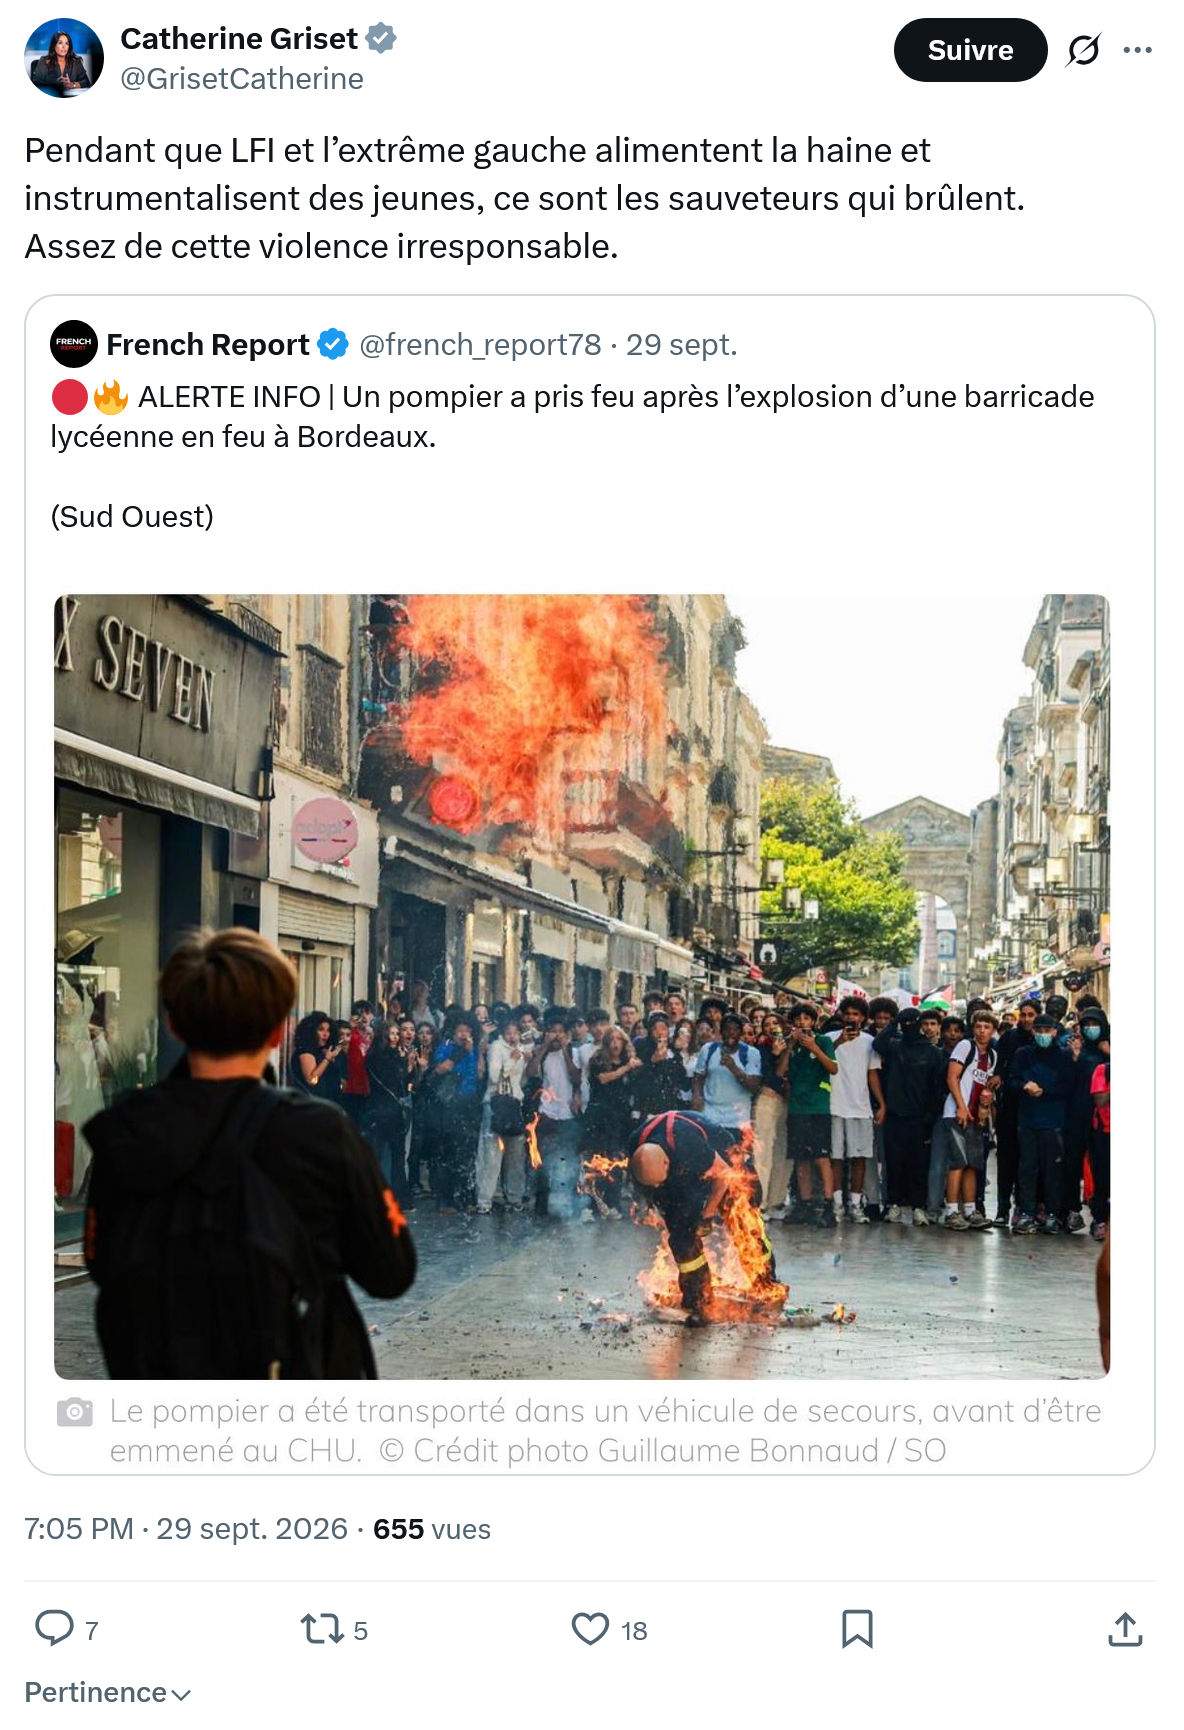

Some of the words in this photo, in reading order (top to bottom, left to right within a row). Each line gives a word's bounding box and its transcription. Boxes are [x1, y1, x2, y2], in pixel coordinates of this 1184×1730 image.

[120, 25, 263, 50] Catherine
[270, 25, 359, 50] Griset
[928, 37, 1014, 61] Suivre
[120, 65, 365, 91] @GrisetCatherine
[26, 135, 156, 163] Pendant
[164, 143, 223, 170] que
[232, 137, 274, 163] LFI
[284, 137, 315, 163] et
[323, 134, 465, 163] l’extrême
[473, 135, 587, 170] gauche
[595, 135, 764, 163] alimentent
[772, 135, 797, 163] la
[807, 135, 892, 163] haine
[900, 137, 932, 163] et
[25, 183, 301, 211] instrumentalisent
[308, 183, 364, 211] des
[370, 183, 484, 218] jeunes,
[493, 191, 530, 211] ce
[538, 185, 608, 211] sont
[617, 183, 660, 211] les
[668, 186, 839, 211] sauveteurs
[848, 183, 895, 218] qui
[905, 182, 1025, 211] brûlent.
[23, 233, 116, 259] Assez
[124, 231, 163, 259] de
[171, 233, 251, 259] cette
[258, 231, 389, 259] violence
[397, 231, 618, 266] irresponsable.
[107, 331, 204, 356] French
[212, 333, 311, 362] Report
[360, 331, 602, 362] @french_report78
[626, 333, 662, 356] 29
[669, 333, 737, 362] sept.
[137, 385, 245, 408] ALERTE
[254, 385, 321, 408] INFO
[343, 384, 380, 408] Un
[389, 383, 504, 414] pompier
[510, 390, 526, 408] a
[534, 383, 584, 414] pris
[590, 383, 634, 408] feu
[642, 383, 719, 414] après
[727, 383, 872, 414] l’explosion
[880, 383, 957, 408] d’une
[965, 383, 1095, 408] barricade
[51, 423, 174, 454] lycéenne
[181, 430, 214, 448] en
[221, 423, 265, 448] feu
[273, 423, 289, 448] à
[298, 423, 436, 448] Bordeaux.
[51, 503, 113, 532] (Sud
[121, 503, 214, 532] Ouest)
[95, 615, 216, 731] SEVEN
[111, 1397, 143, 1423] Le
[153, 1398, 270, 1430] pompier
[278, 1404, 294, 1423] a
[304, 1396, 348, 1423] été
[356, 1396, 505, 1430] transporté
[515, 1397, 585, 1423] dans
[595, 1404, 628, 1423] un
[638, 1395, 754, 1423] véhicule
[763, 1397, 798, 1423] de
[808, 1404, 923, 1426] secours,
[933, 1400, 1015, 1423] avant
[1023, 1396, 1102, 1423] d’être
[110, 1435, 234, 1463] emmené
[243, 1444, 278, 1463] au
[288, 1437, 362, 1463] CHU.
[379, 1437, 405, 1463] ©
[414, 1435, 499, 1463] Crédit
[508, 1437, 589, 1469] photo
[598, 1436, 740, 1463] Guillaume
[750, 1436, 878, 1463] Bonnaud
[904, 1437, 947, 1463] SO
[24, 1517, 83, 1540] 7:05
[92, 1517, 133, 1540] PM
[156, 1517, 192, 1540] 29
[199, 1517, 268, 1546] sept.
[275, 1517, 348, 1540] 2026
[373, 1518, 425, 1540] 655
[431, 1523, 491, 1540] vues
[85, 1621, 99, 1641] 7
[353, 1621, 369, 1641] 5
[621, 1621, 648, 1641] 18
[25, 1680, 167, 1703] Pertinence
